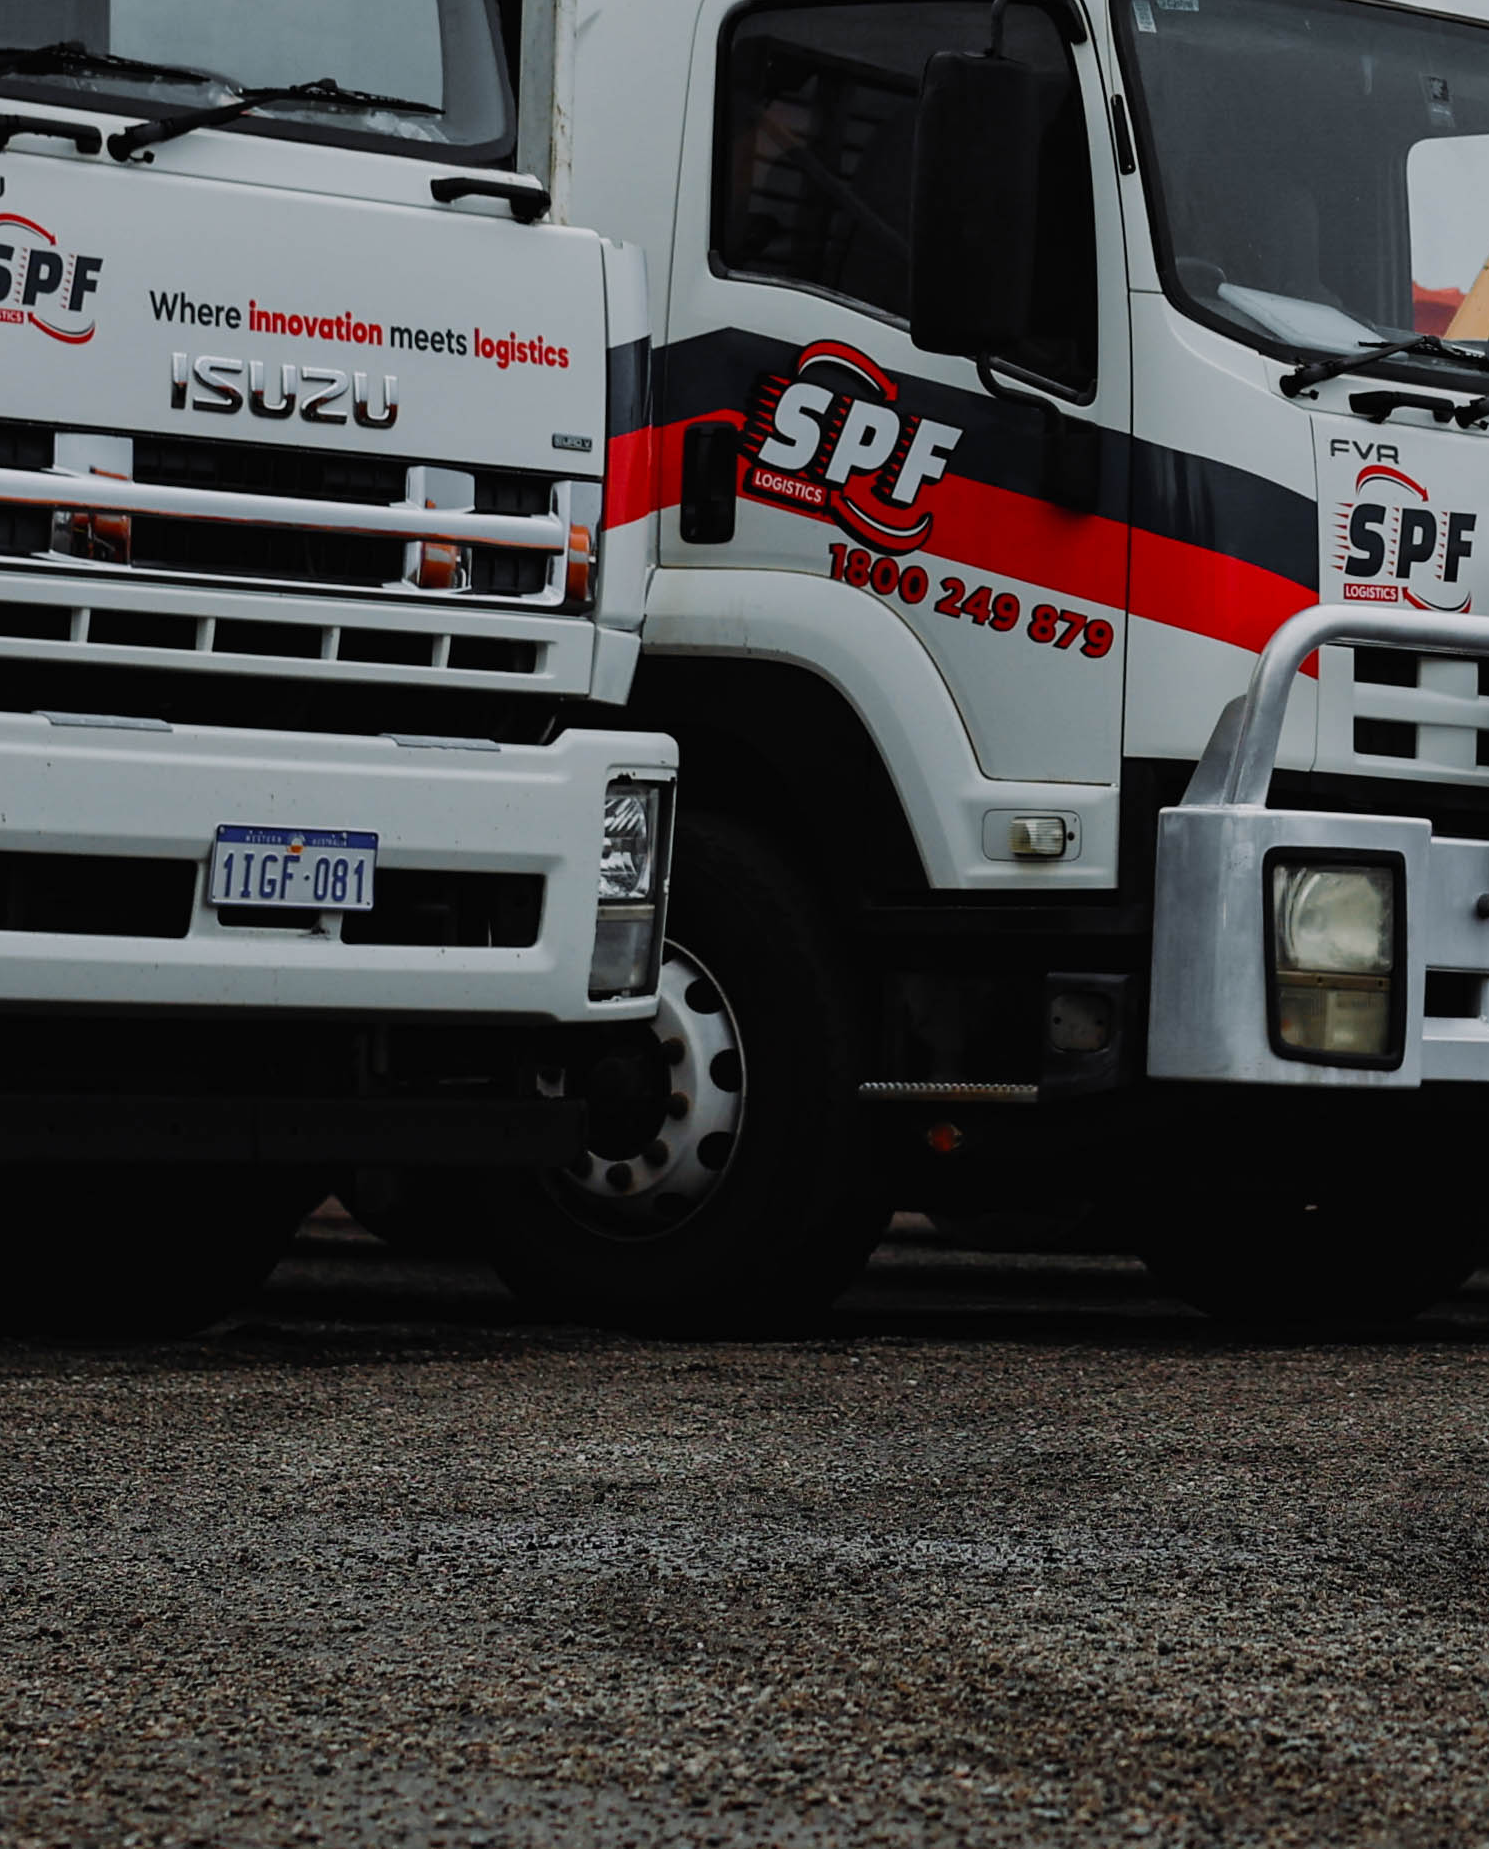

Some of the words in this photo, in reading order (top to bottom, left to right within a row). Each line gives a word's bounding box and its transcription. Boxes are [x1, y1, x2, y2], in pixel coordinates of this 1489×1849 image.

[150, 291, 241, 328] Where
[249, 300, 383, 346] innovation
[390, 324, 468, 356] meets
[474, 328, 570, 369] logistics
[170, 352, 399, 430] ISUZU
[758, 382, 963, 504] SPF
[1330, 439, 1399, 464] FVR
[755, 470, 822, 503] LOGISTICS
[1345, 503, 1477, 582] SPF
[829, 543, 928, 604] 1800
[934, 577, 1021, 631] 249
[1028, 604, 1114, 659] 879
[1346, 585, 1396, 599] LOGISTICS
